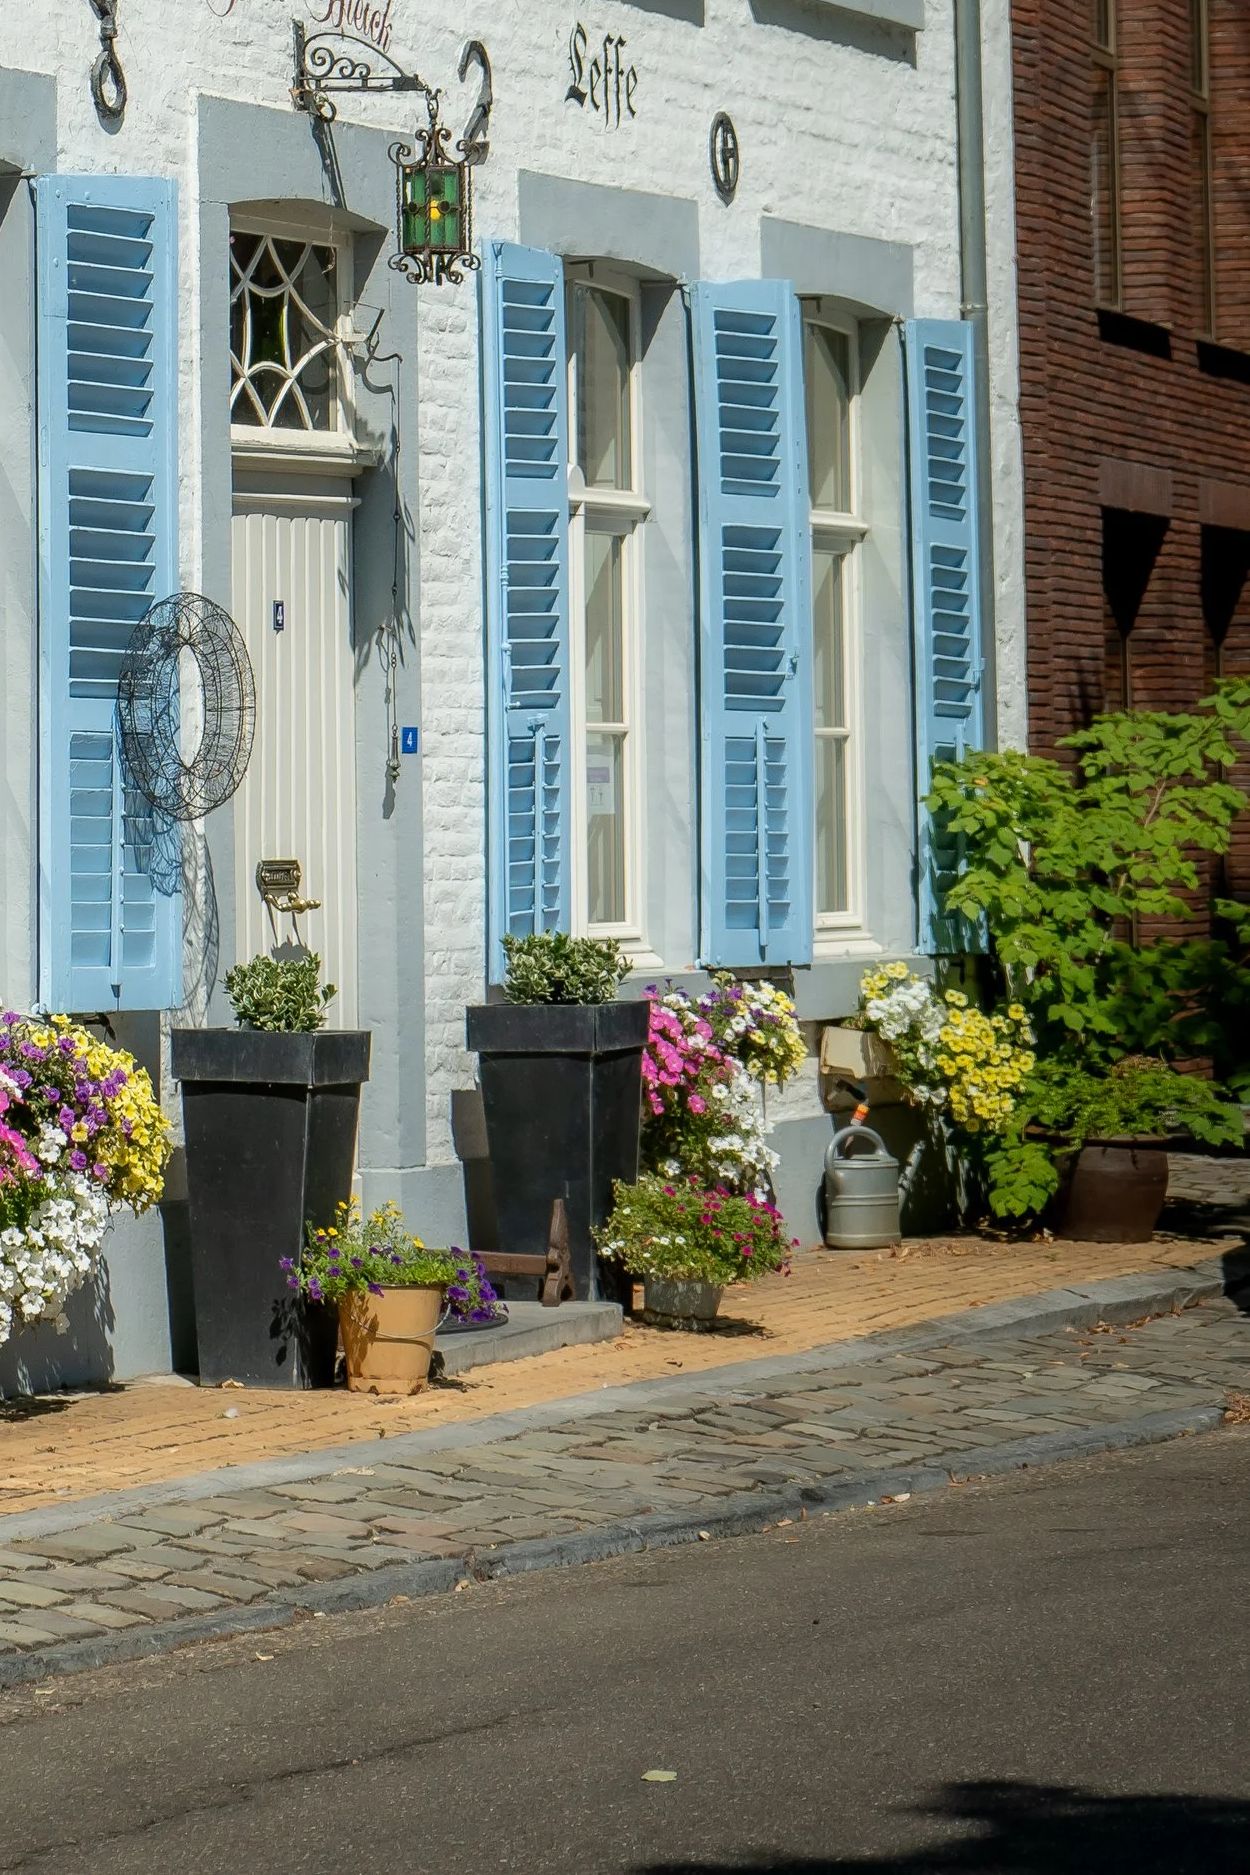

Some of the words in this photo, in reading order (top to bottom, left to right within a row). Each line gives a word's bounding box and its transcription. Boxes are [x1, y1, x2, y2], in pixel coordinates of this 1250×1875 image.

[564, 21, 638, 131] Leffe
[276, 605, 283, 624] 4
[406, 731, 413, 747] 4
